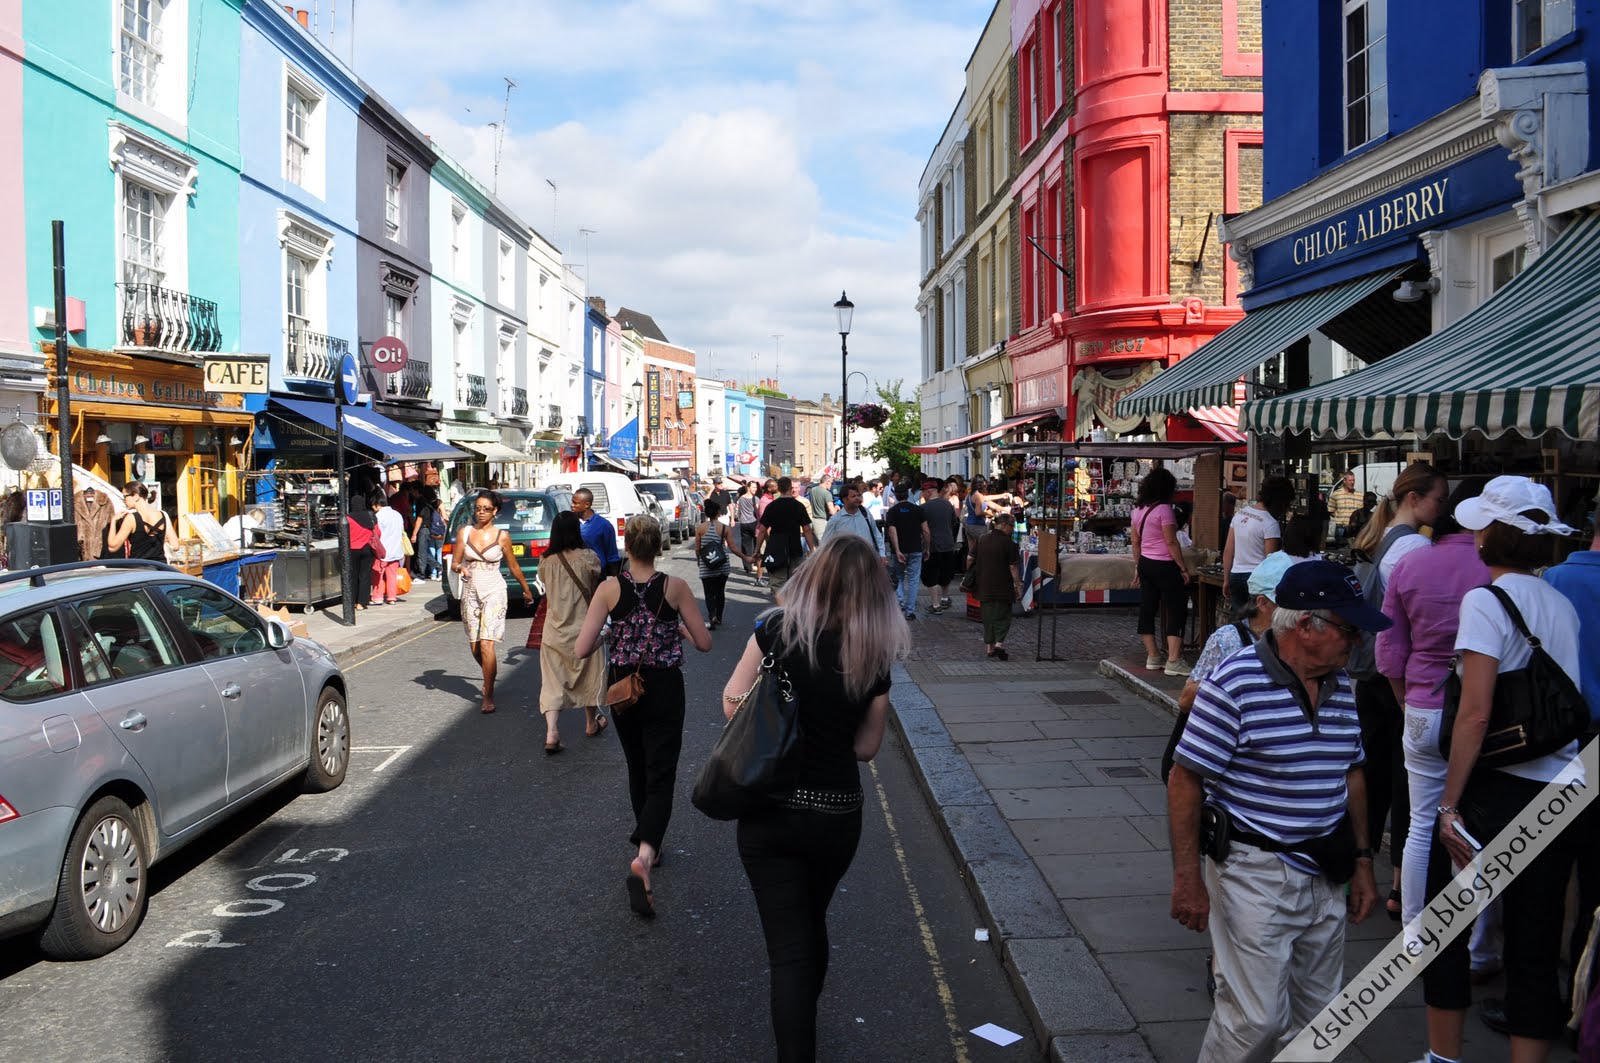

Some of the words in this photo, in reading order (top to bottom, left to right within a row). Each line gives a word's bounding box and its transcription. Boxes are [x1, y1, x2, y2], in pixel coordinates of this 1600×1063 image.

[1293, 220, 1347, 265] CHLOE
[1354, 179, 1448, 244] ALBERRY
[374, 347, 402, 363] Oi!
[74, 370, 146, 398] Chelsea
[207, 362, 264, 386] CAFE
[650, 374, 658, 391] THE
[650, 394, 658, 417] GOLD
